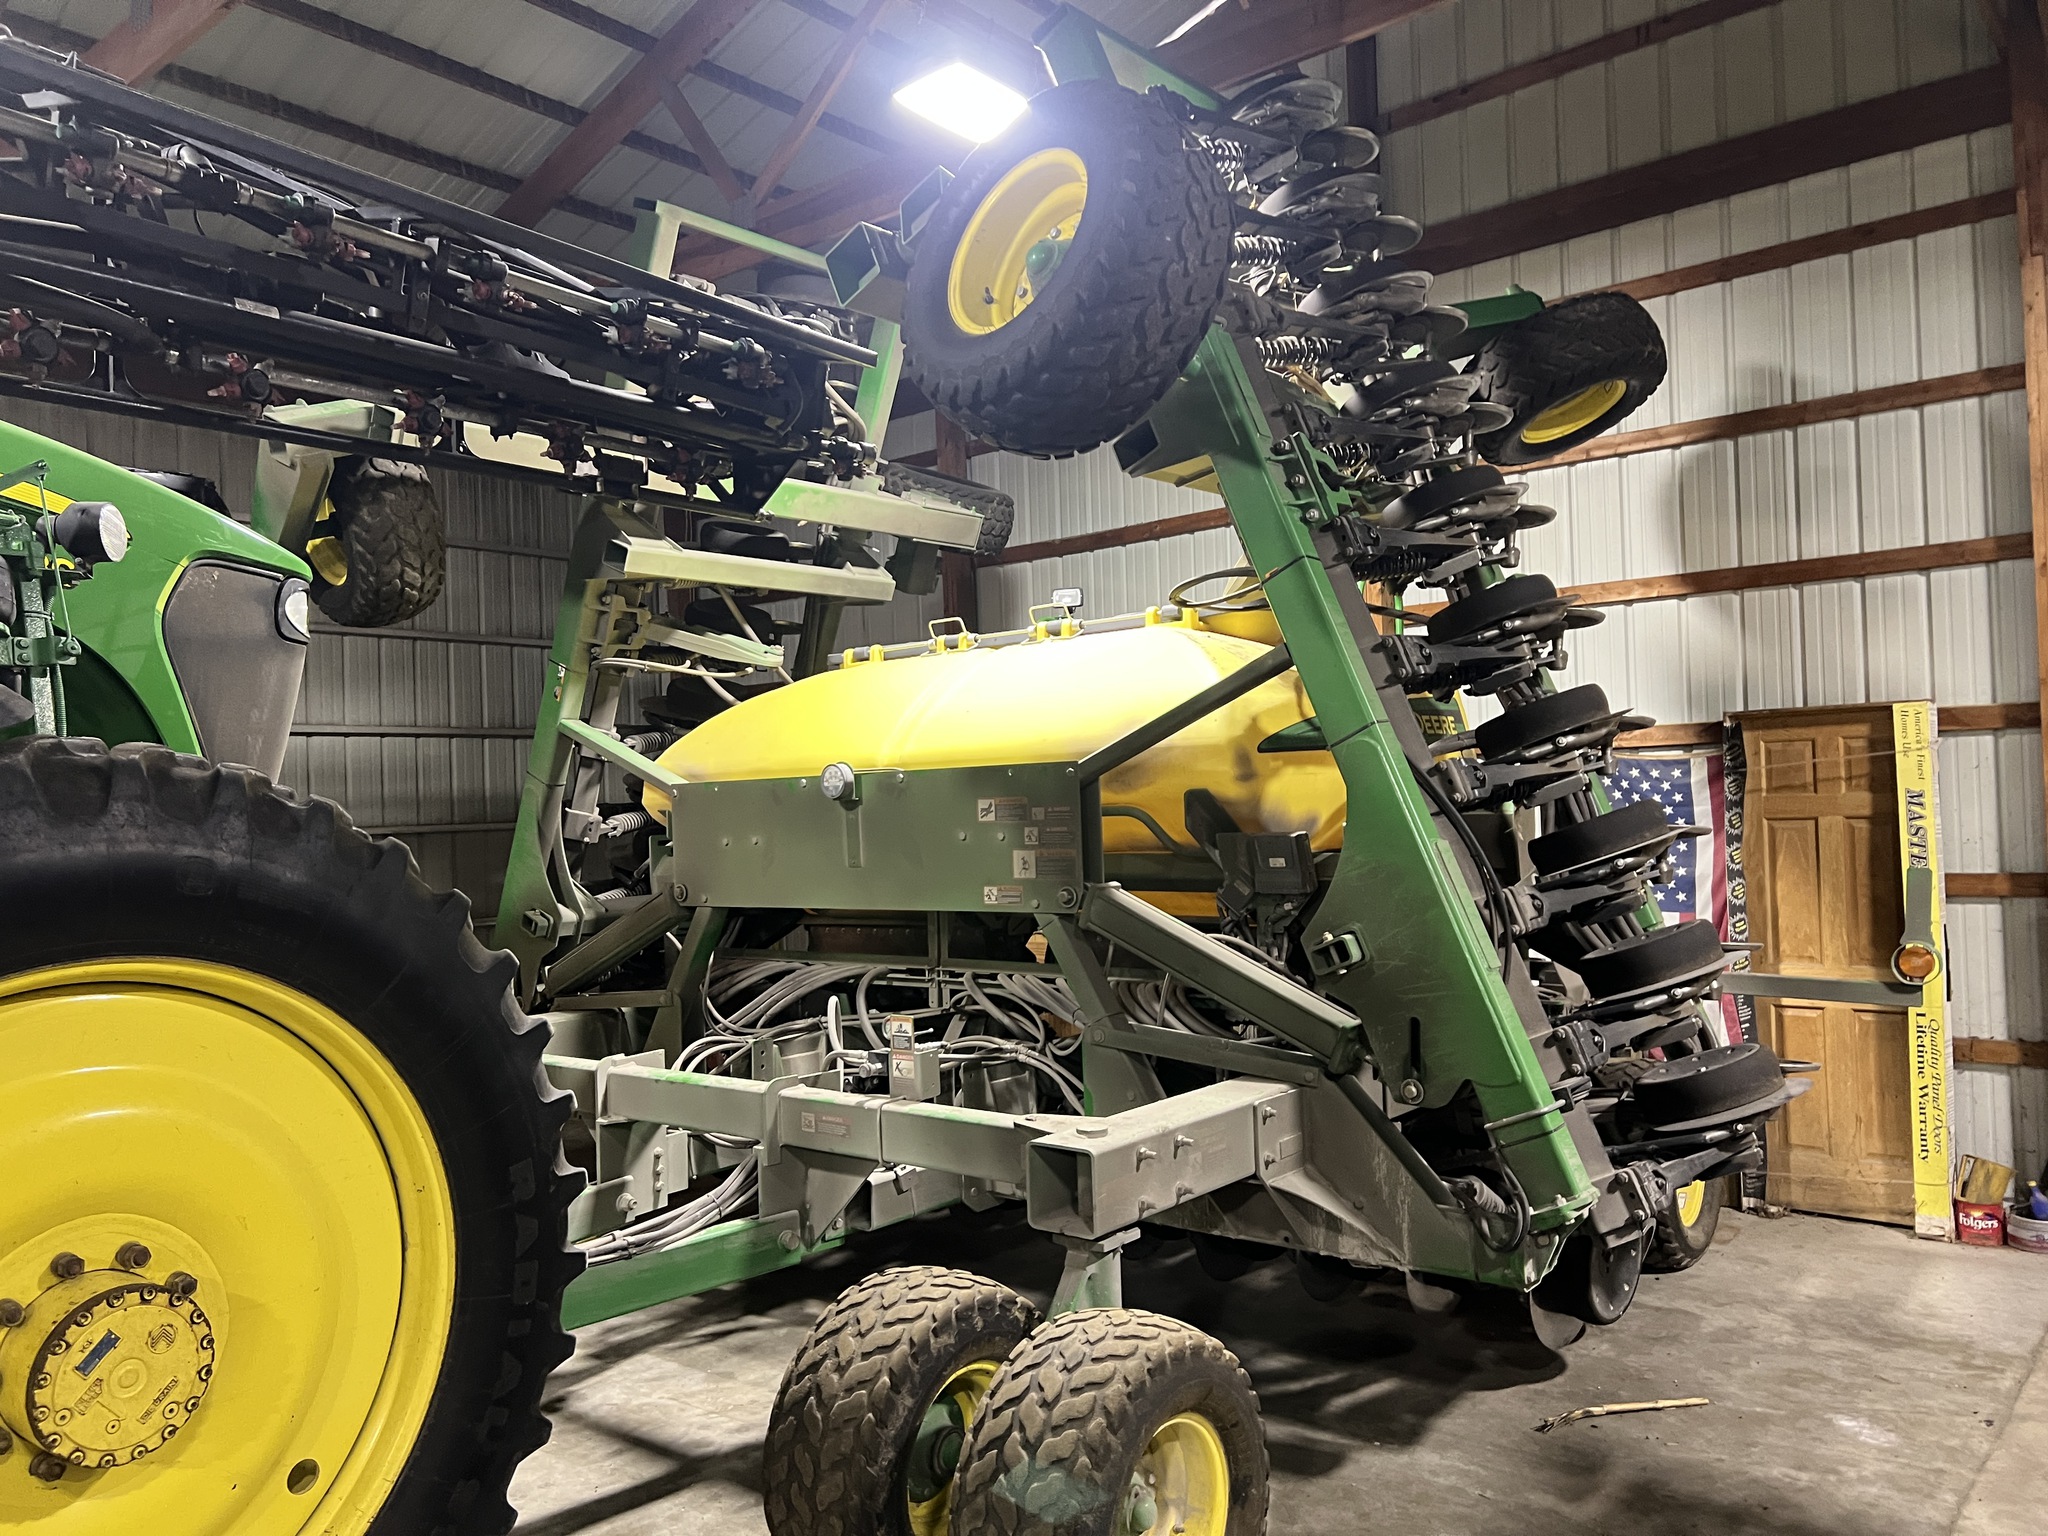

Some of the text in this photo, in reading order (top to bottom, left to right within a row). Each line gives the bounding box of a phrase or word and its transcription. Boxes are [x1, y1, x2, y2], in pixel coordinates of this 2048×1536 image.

[1415, 713, 1458, 735] DEERE
[1900, 709, 1912, 759] Homes Use
[1916, 754, 1926, 780] Finest
[1905, 788, 1929, 868] MASTE
[1915, 1012, 1931, 1164] Lifetime Warranty
[1926, 1019, 1944, 1155] Quality Panel Doors
[1958, 1212, 1999, 1230] Folgers
[153, 1378, 178, 1407] DRAIN
